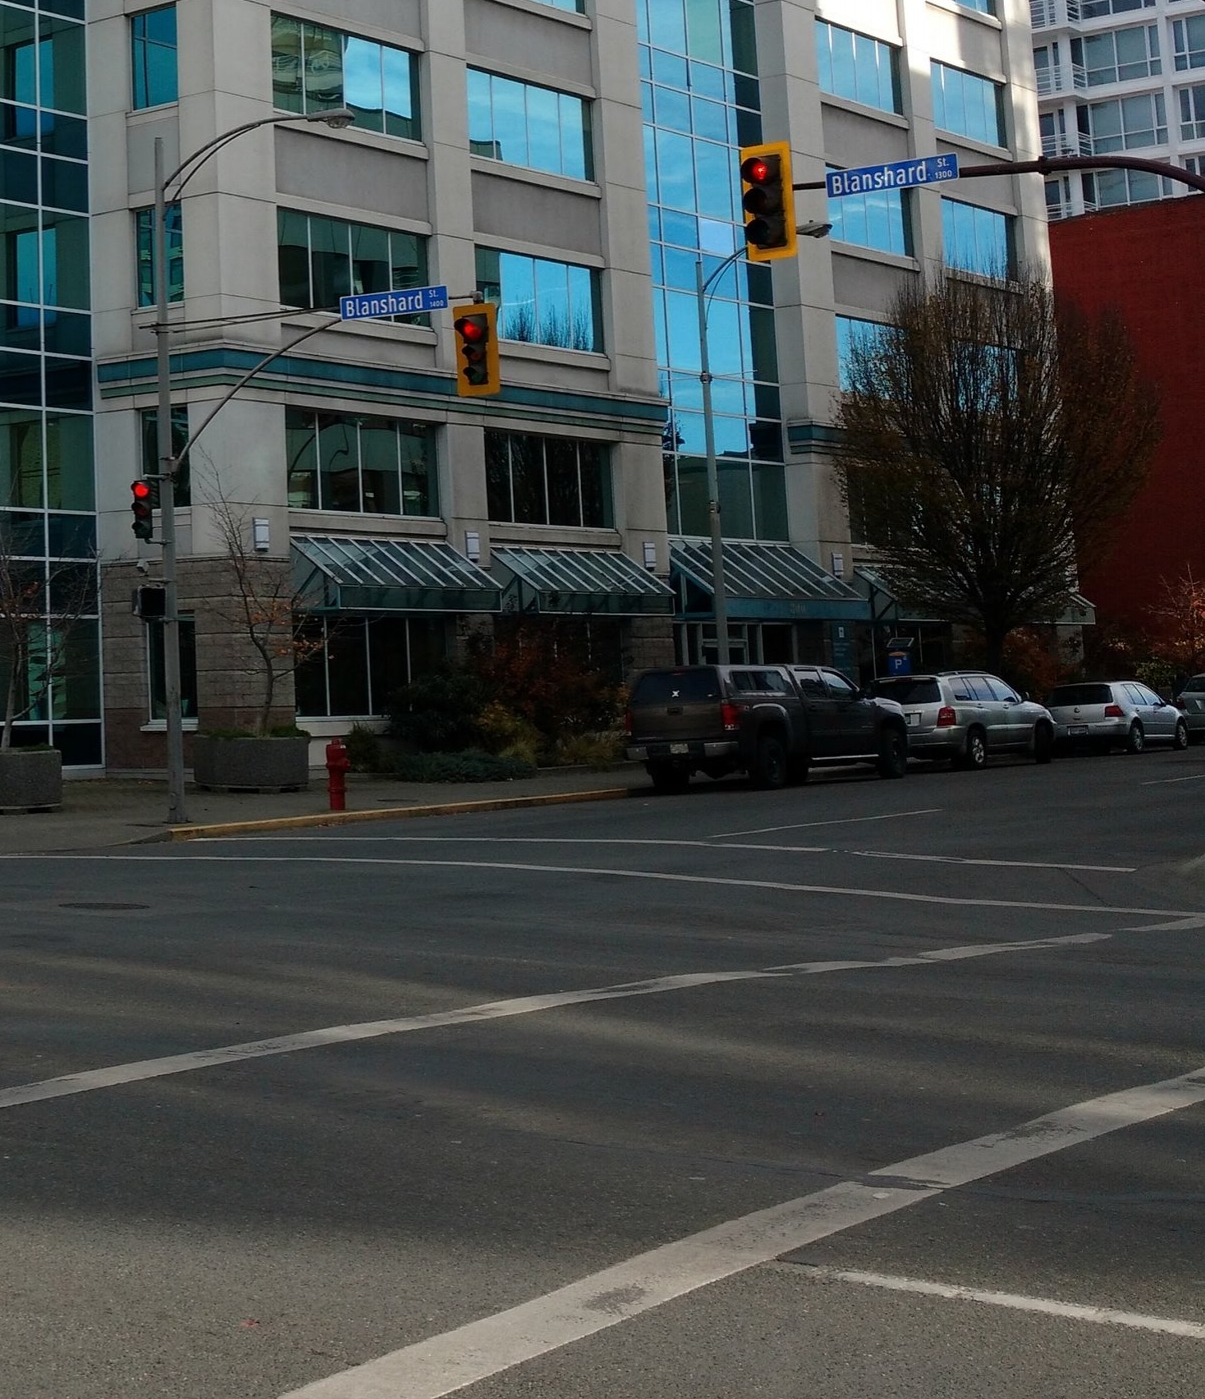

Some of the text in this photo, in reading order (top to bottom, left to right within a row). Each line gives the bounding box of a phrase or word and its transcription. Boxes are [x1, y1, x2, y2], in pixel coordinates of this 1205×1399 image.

[832, 157, 950, 195] Blanshard St.
[935, 169, 953, 179] 1300
[346, 289, 439, 317] Blanshard St.
[429, 300, 444, 308] 1400
[895, 659, 903, 669] P
